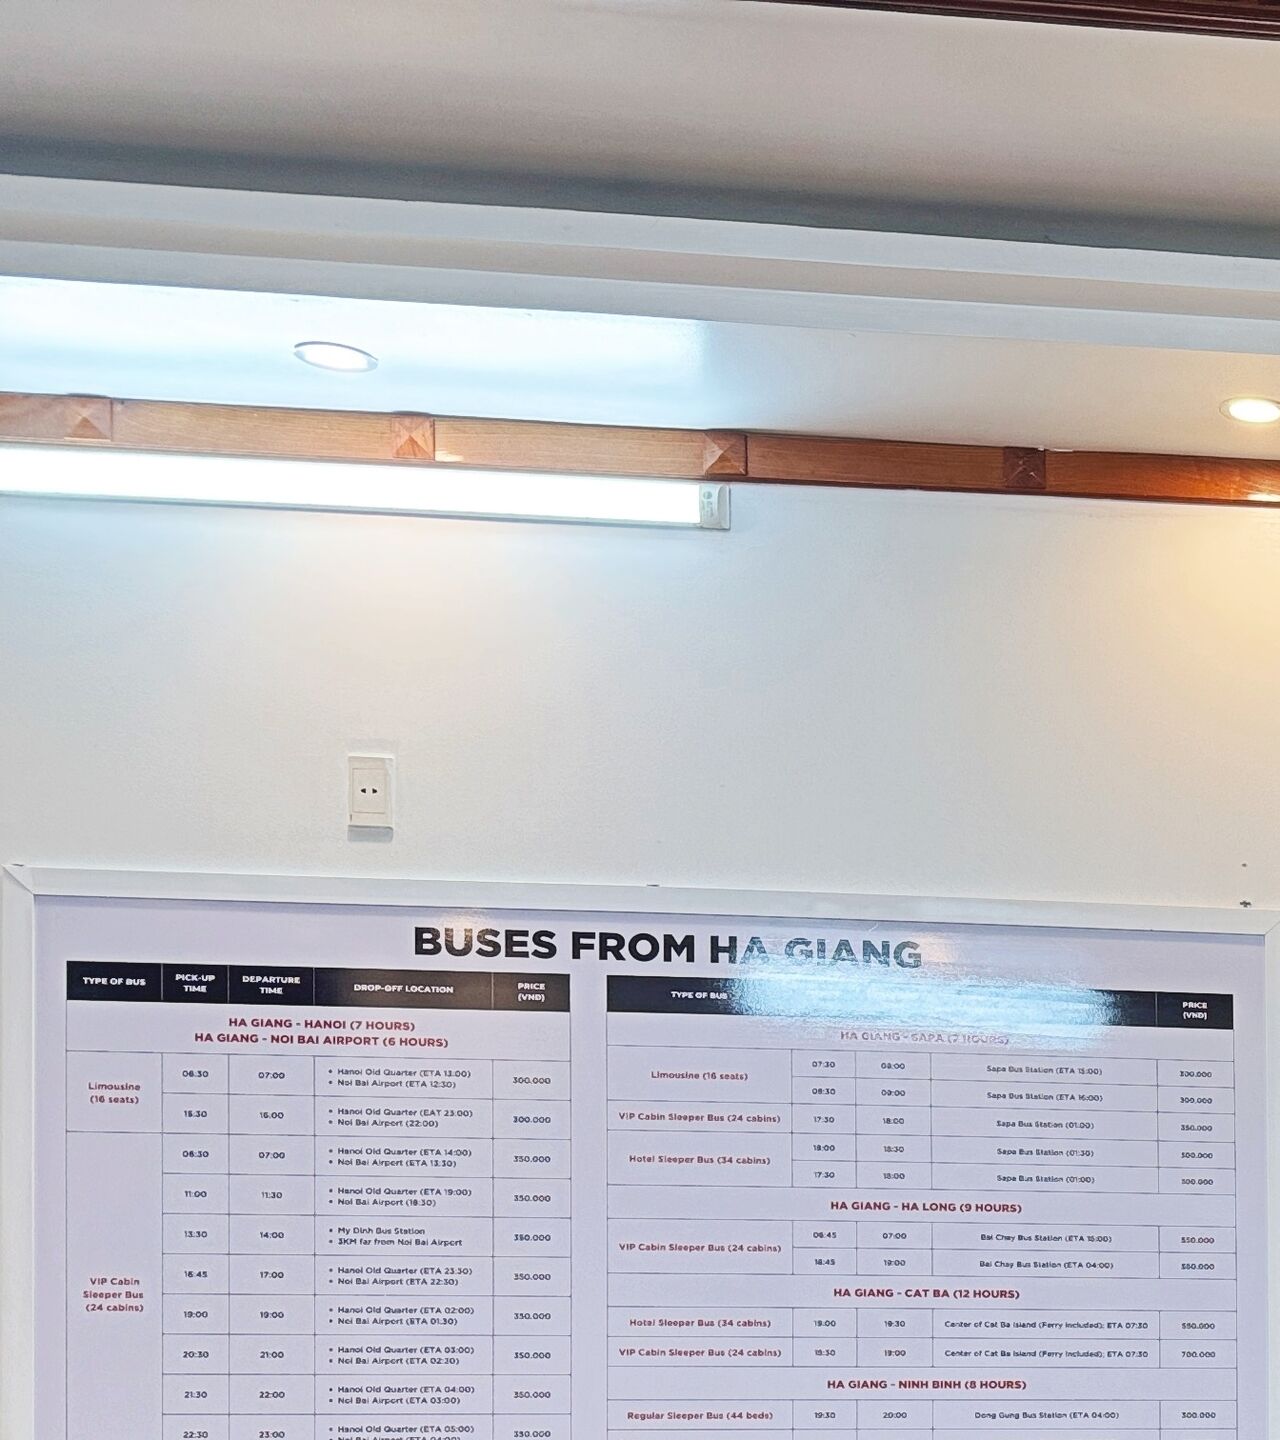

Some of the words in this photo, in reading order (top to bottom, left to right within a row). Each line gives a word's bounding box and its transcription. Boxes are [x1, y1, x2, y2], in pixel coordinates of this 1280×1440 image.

[414, 927, 557, 960] BUSES
[572, 932, 695, 962] FROM
[710, 936, 769, 964] HA
[784, 938, 922, 968] GIANG
[82, 977, 108, 985] TYPE
[109, 977, 124, 985] OF
[125, 978, 146, 986] BUS
[242, 975, 300, 984] DEPARTURE
[354, 984, 403, 992] DROP-OFF
[405, 985, 453, 993] LOCATION
[517, 982, 545, 990] PRICE
[518, 993, 545, 1002] (VND)
[1182, 1001, 1207, 1009] PRICE
[1182, 1011, 1207, 1020] (VND)
[228, 1018, 247, 1027] HA
[250, 1018, 292, 1028] GIANG
[304, 1020, 346, 1029] HANOI
[350, 1020, 362, 1030] (7
[366, 1021, 415, 1031] HOURS)
[194, 1033, 213, 1042] HA
[216, 1033, 259, 1043] GIANG
[270, 1034, 293, 1044] NOI
[297, 1035, 319, 1044] BAI
[322, 1036, 379, 1045] AIRPORT
[382, 1037, 395, 1047] (6
[399, 1038, 448, 1048] HOURS)
[88, 1082, 141, 1091] Limousine
[184, 1190, 207, 1198] 11:00
[261, 1191, 283, 1199] 11:30
[830, 1201, 848, 1210] HA
[851, 1201, 891, 1210] GIANG
[901, 1202, 919, 1211] HA
[922, 1202, 956, 1212] LONG
[959, 1203, 972, 1213] (9
[975, 1203, 1022, 1213] HOURS)
[260, 1271, 284, 1279] 17:00
[90, 1277, 107, 1285] VIP
[110, 1277, 140, 1286] Cabin
[82, 1290, 122, 1299] Sleeper
[125, 1291, 144, 1299] Bus
[834, 1288, 851, 1297] HA
[854, 1288, 894, 1297] GIANG
[904, 1289, 930, 1298] CAT
[932, 1289, 950, 1298] BA
[953, 1289, 970, 1299] (12
[973, 1290, 1020, 1299] HOURS)
[106, 1304, 144, 1312] cabins)
[827, 1380, 845, 1389] HA
[848, 1380, 887, 1389] GIANG
[898, 1380, 928, 1389] NINH
[932, 1380, 961, 1389] BINH
[964, 1380, 977, 1390] (8
[980, 1380, 1027, 1389] HOURS)
